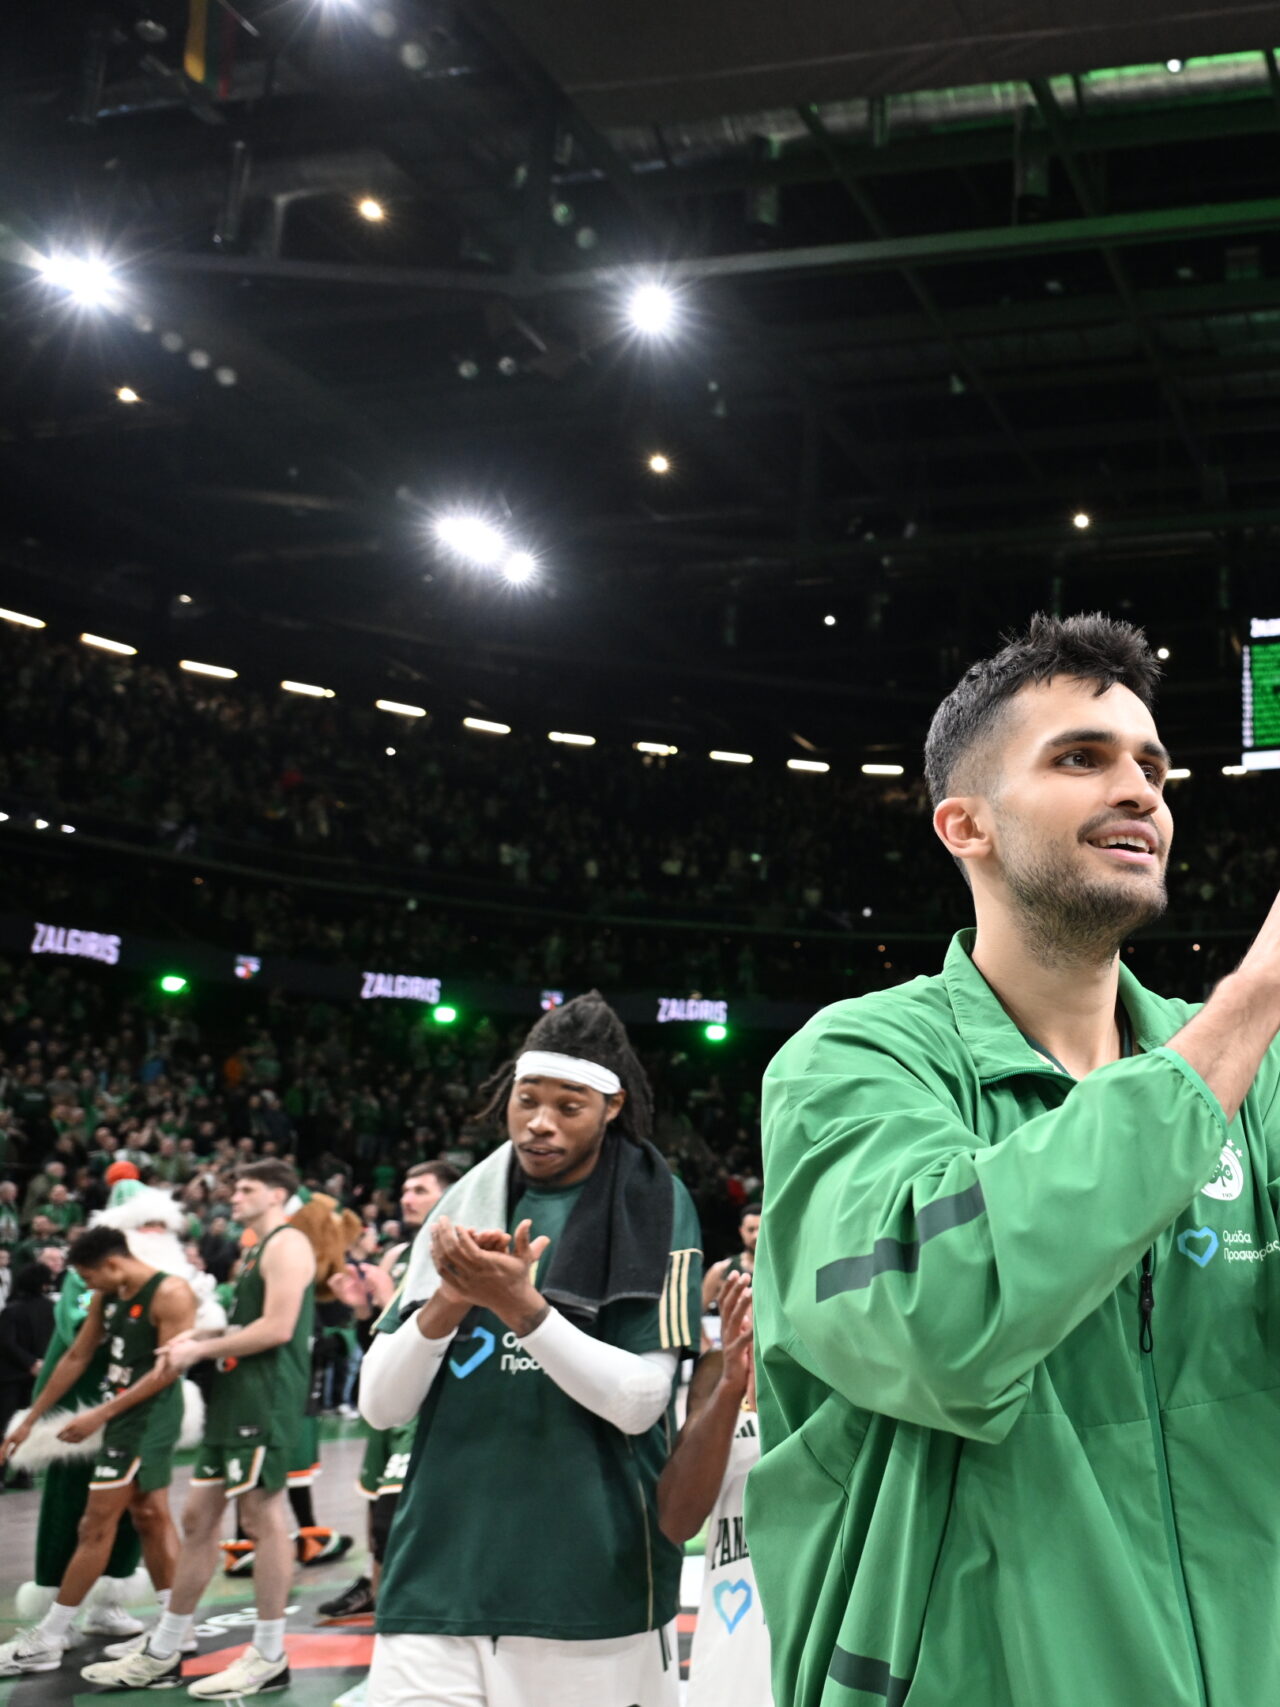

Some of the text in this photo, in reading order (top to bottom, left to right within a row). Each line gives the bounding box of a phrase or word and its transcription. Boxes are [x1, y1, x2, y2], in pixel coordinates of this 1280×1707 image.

[31, 922, 121, 965] ZALGIRIS
[360, 971, 441, 1004] ZALGIRIS
[656, 997, 728, 1024] ZALGIRIS
[1222, 1230, 1252, 1246] Ομάδα
